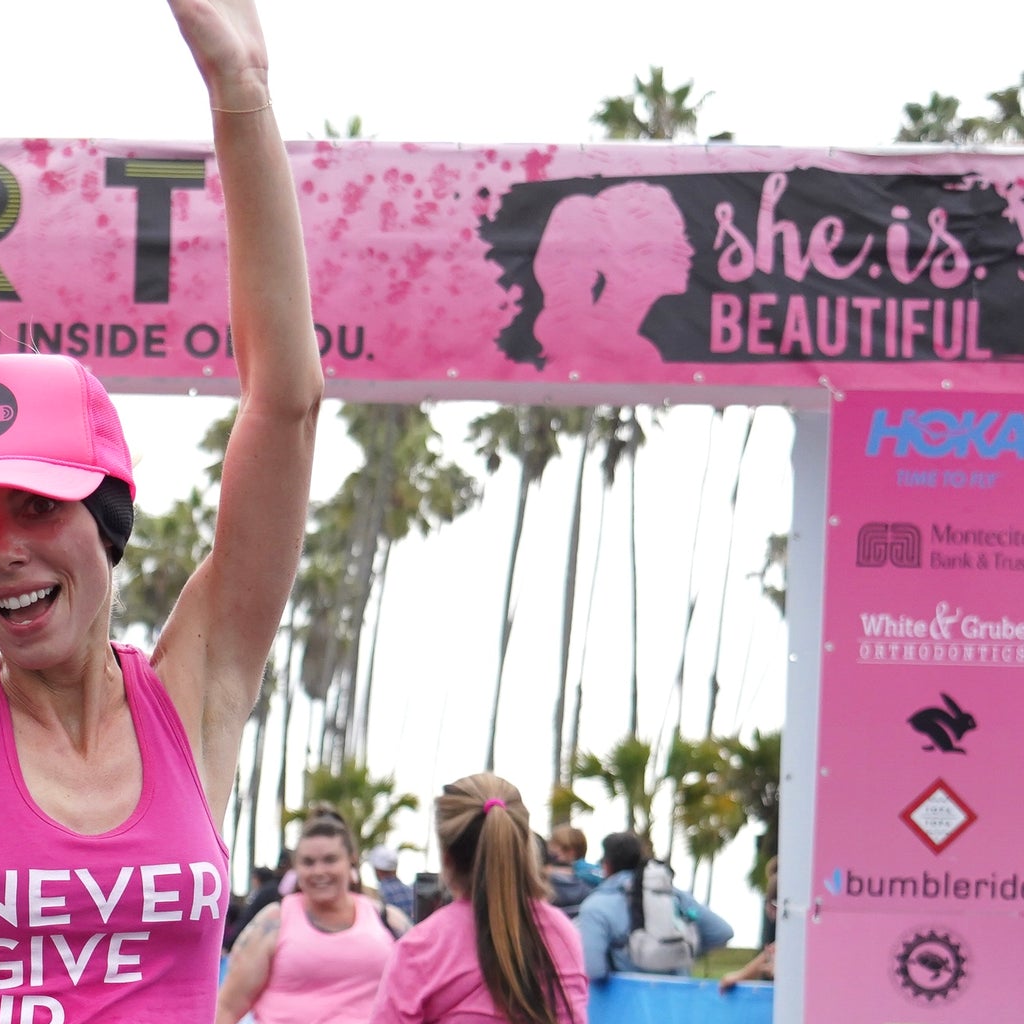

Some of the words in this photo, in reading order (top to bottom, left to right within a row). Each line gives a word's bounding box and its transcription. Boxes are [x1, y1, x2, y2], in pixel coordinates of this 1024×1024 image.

[18, 323, 167, 358] INSIDE
[184, 323, 234, 359] O
[710, 292, 993, 361] BEAUTIFUL
[864, 409, 1024, 459] HOKA
[897, 469, 938, 488] TIME
[943, 470, 967, 488] TO
[970, 471, 998, 489] FLY
[930, 551, 971, 570] Bank
[976, 552, 989, 570] &
[860, 612, 927, 638] White
[846, 868, 1024, 900] bumblerid
